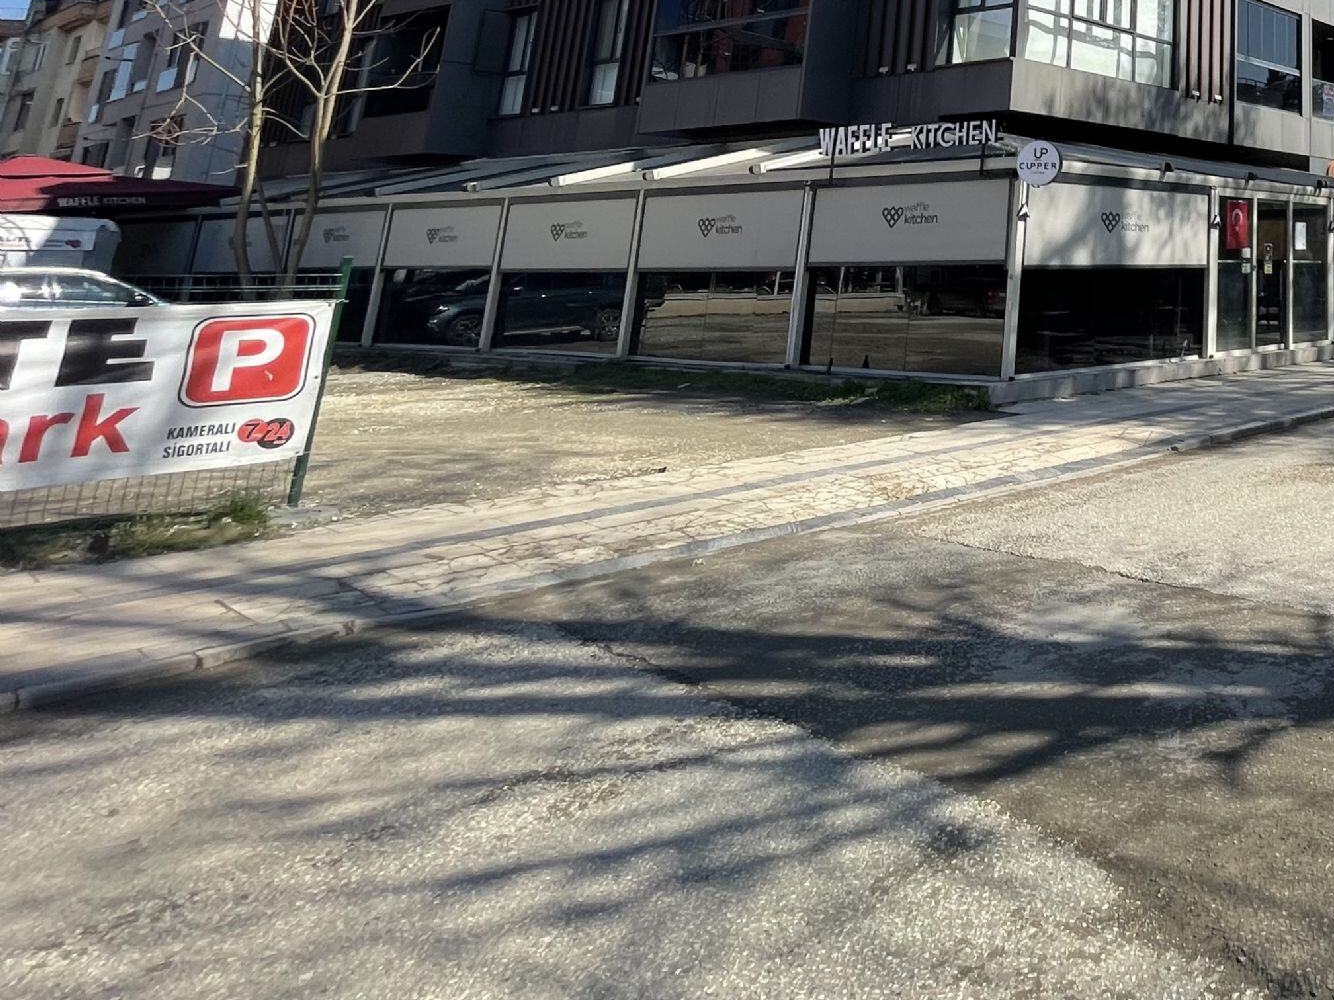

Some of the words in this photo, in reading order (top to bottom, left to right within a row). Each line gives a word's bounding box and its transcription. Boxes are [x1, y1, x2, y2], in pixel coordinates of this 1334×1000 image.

[819, 122, 891, 156] WAFFLE
[911, 119, 998, 149] KITCHEN
[1034, 147, 1048, 159] UP
[1019, 162, 1057, 170] CUPPER
[904, 202, 930, 212] waffle
[904, 213, 938, 224] kitchen
[715, 224, 743, 235] kitchen
[1121, 222, 1149, 232] kitchen
[210, 328, 285, 393] P
[0, 393, 141, 465] rk
[166, 422, 237, 440] KAMERALI
[162, 441, 231, 459] SİGORTALI
